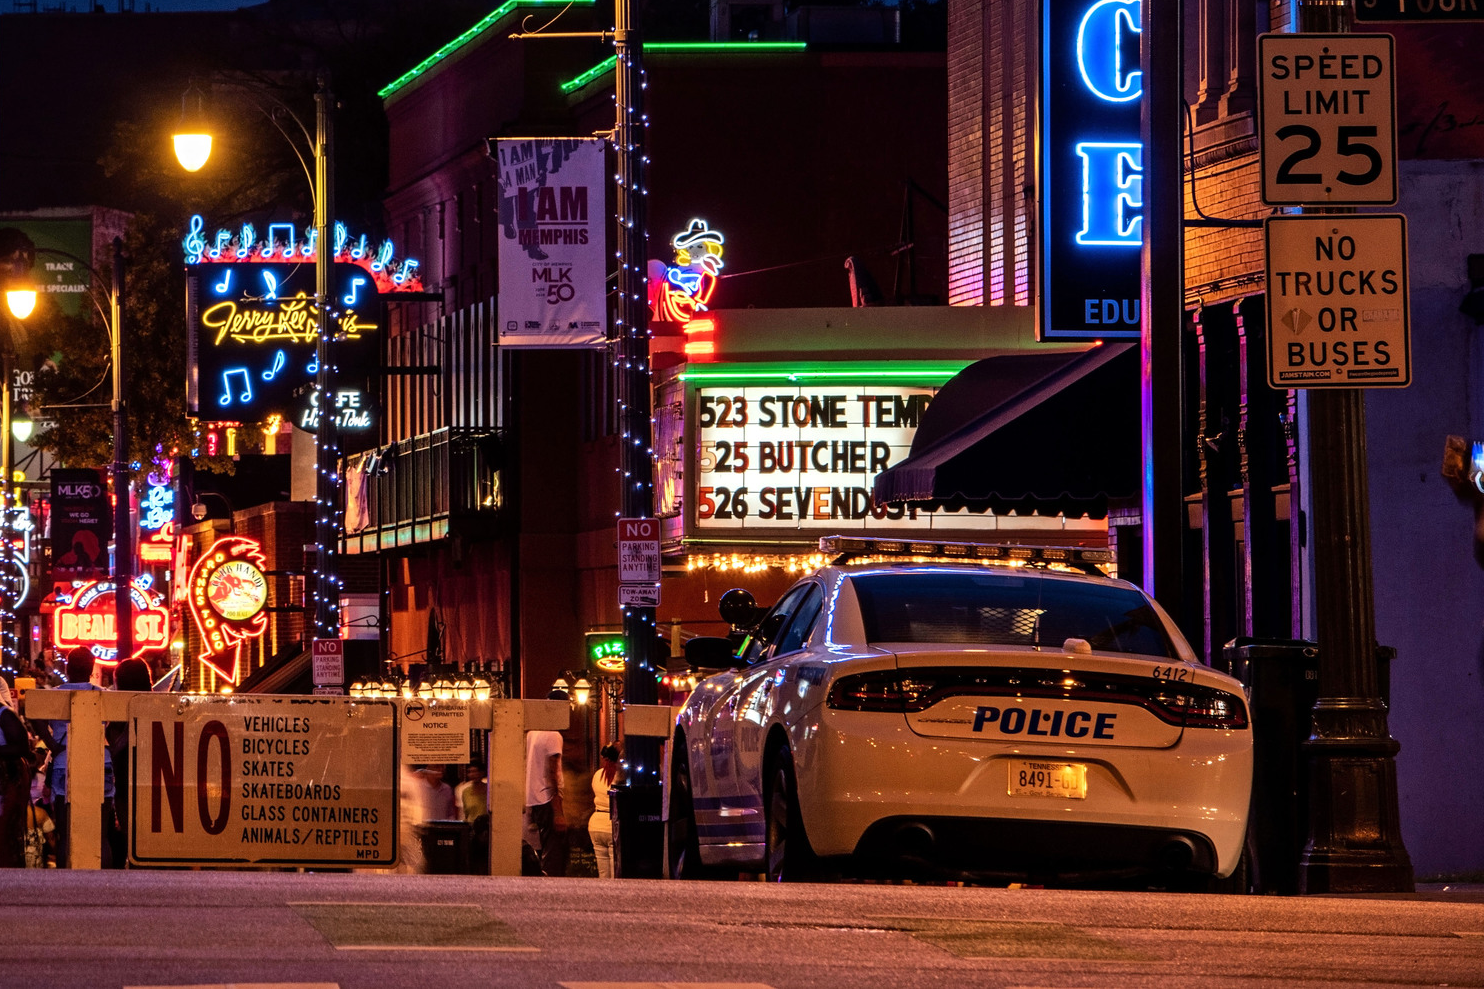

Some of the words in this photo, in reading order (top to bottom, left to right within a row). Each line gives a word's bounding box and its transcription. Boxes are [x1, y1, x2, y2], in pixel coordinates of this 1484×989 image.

[1271, 55, 1383, 80] SPEED
[1283, 90, 1370, 115] LIMIT
[1275, 125, 1383, 187] 25
[536, 186, 589, 221] AM
[518, 228, 589, 245] MEMPHIS
[1315, 235, 1356, 261] NO
[532, 267, 573, 283] MLK
[1275, 269, 1399, 297] TRUCKS
[546, 283, 576, 305] 50
[202, 300, 275, 346] Jerry
[1318, 307, 1358, 333] OR
[1287, 340, 1391, 367] BUSES
[310, 391, 360, 408] CFE
[700, 395, 749, 429] 523
[758, 395, 848, 429] STONE
[699, 440, 750, 474] 525
[759, 439, 891, 474] BUTCHER
[698, 486, 749, 520] 526
[626, 523, 652, 537] NO
[622, 542, 655, 551] PARKING
[622, 554, 658, 563] STANDING
[622, 563, 658, 572] ANYTIME
[196, 552, 225, 606] DRINKS
[236, 563, 264, 588] HANDY
[622, 588, 657, 596] TOW-AWAY
[60, 613, 118, 641] BEAL
[201, 609, 216, 628] TO
[211, 631, 224, 650] GO
[318, 642, 337, 653] NO
[316, 671, 342, 679] ANYTIME
[1152, 665, 1188, 683] 6412
[972, 705, 1118, 740] POLICE
[242, 739, 310, 756] BICYCLES
[151, 719, 232, 836] NO
[244, 716, 310, 734] VEHICLES
[242, 761, 295, 777] SKATES
[242, 783, 341, 801] SKATEBOARDS
[241, 805, 285, 822] GLASS
[292, 807, 378, 825] CONTAINERS
[241, 827, 379, 847] ANIMALS/REPTILES
[356, 849, 380, 859] MPD
